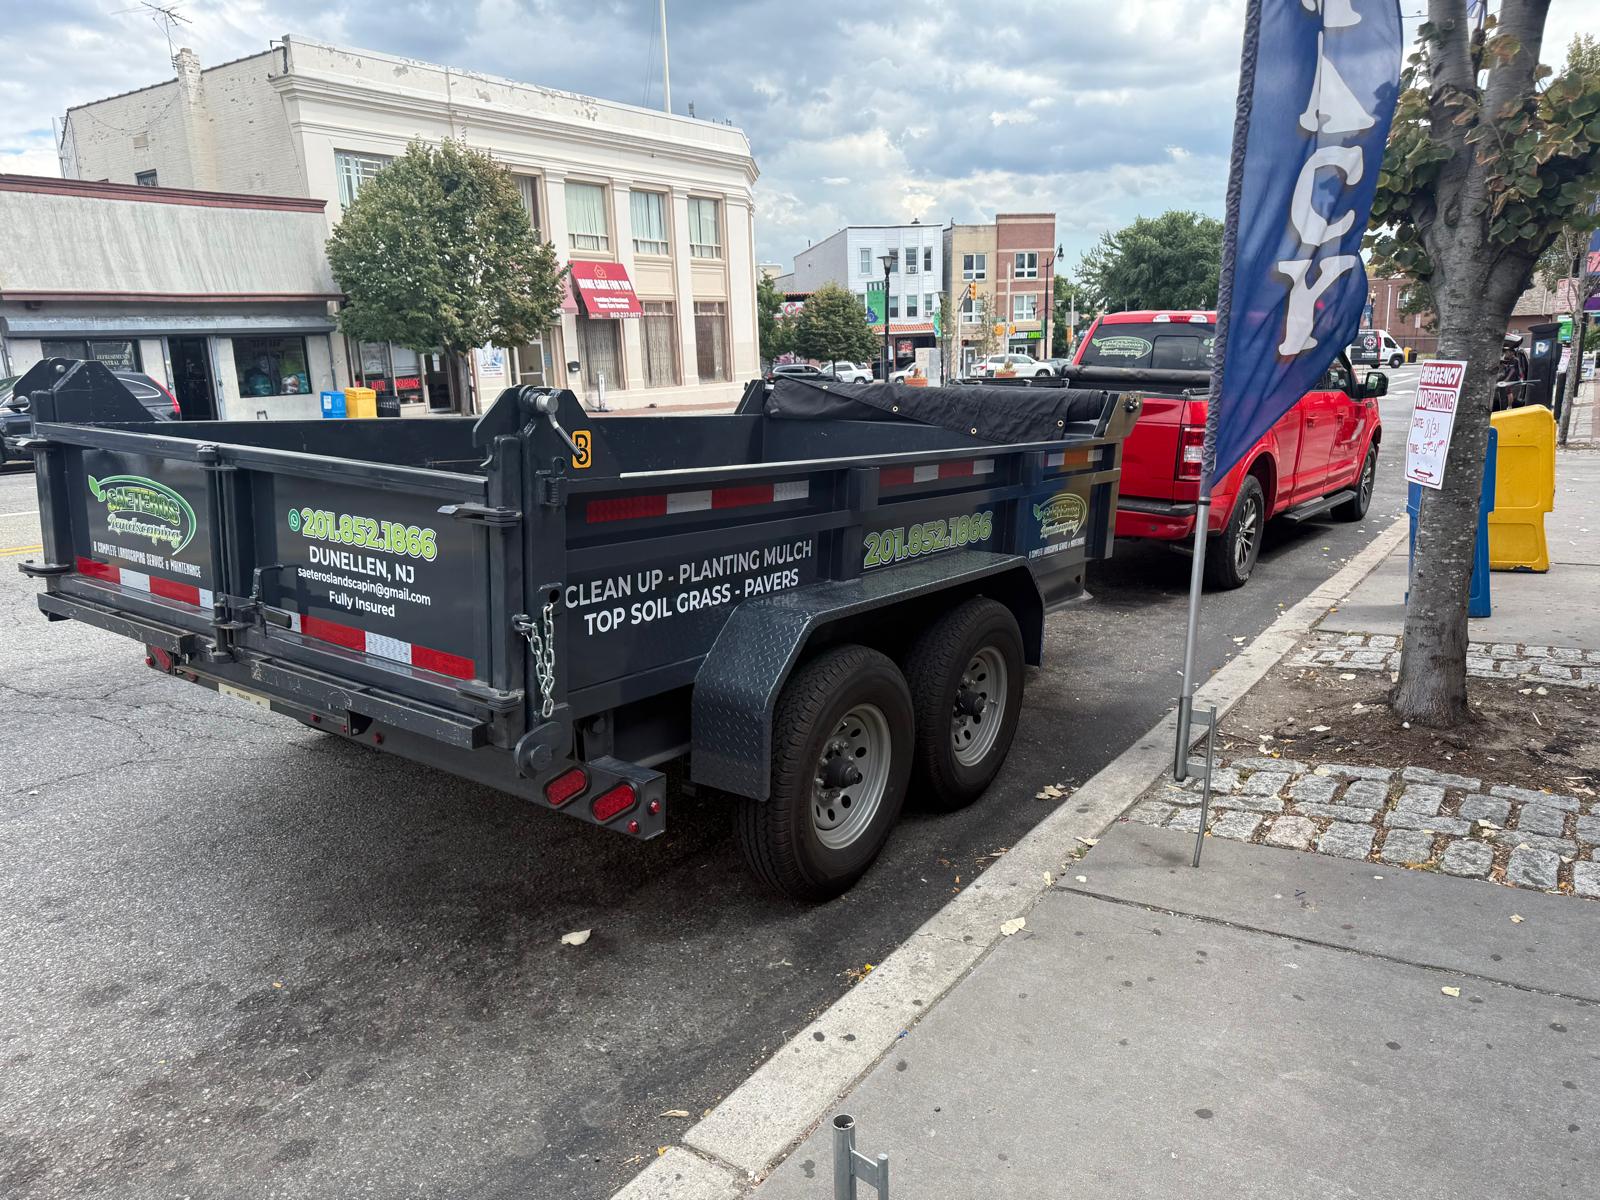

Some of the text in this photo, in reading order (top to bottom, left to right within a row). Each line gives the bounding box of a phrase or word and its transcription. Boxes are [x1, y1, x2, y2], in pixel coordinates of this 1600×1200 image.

[594, 279, 611, 289] CARE
[608, 280, 622, 290] FOR
[618, 280, 632, 291] YOU
[372, 380, 386, 391] AUTO
[1420, 365, 1461, 385] EMERGENCY
[1416, 389, 1455, 410] NO PARKING
[106, 486, 181, 526] SAETEROS
[107, 513, 183, 549] Landscaping
[301, 507, 437, 562] 201.852.1866
[863, 511, 993, 569] 201.852.1866
[97, 541, 117, 557] COMPLETE
[117, 546, 146, 565] LANDSCAPING
[146, 553, 164, 570] SERVICE
[170, 559, 202, 578] MAINTENANCE
[309, 545, 415, 583] DUNELLEN, NJ
[565, 574, 631, 609] CLEAN
[637, 569, 663, 592] UP
[679, 549, 760, 585] PLANTING
[764, 540, 812, 567] MULCH
[297, 567, 431, 606] saeteroslandscapin@gmail.com
[329, 591, 396, 617] Fully Insured
[584, 607, 625, 635] TOP
[630, 597, 672, 625] SOIL
[676, 583, 731, 614] GRASS
[745, 568, 799, 598] PAVERS
